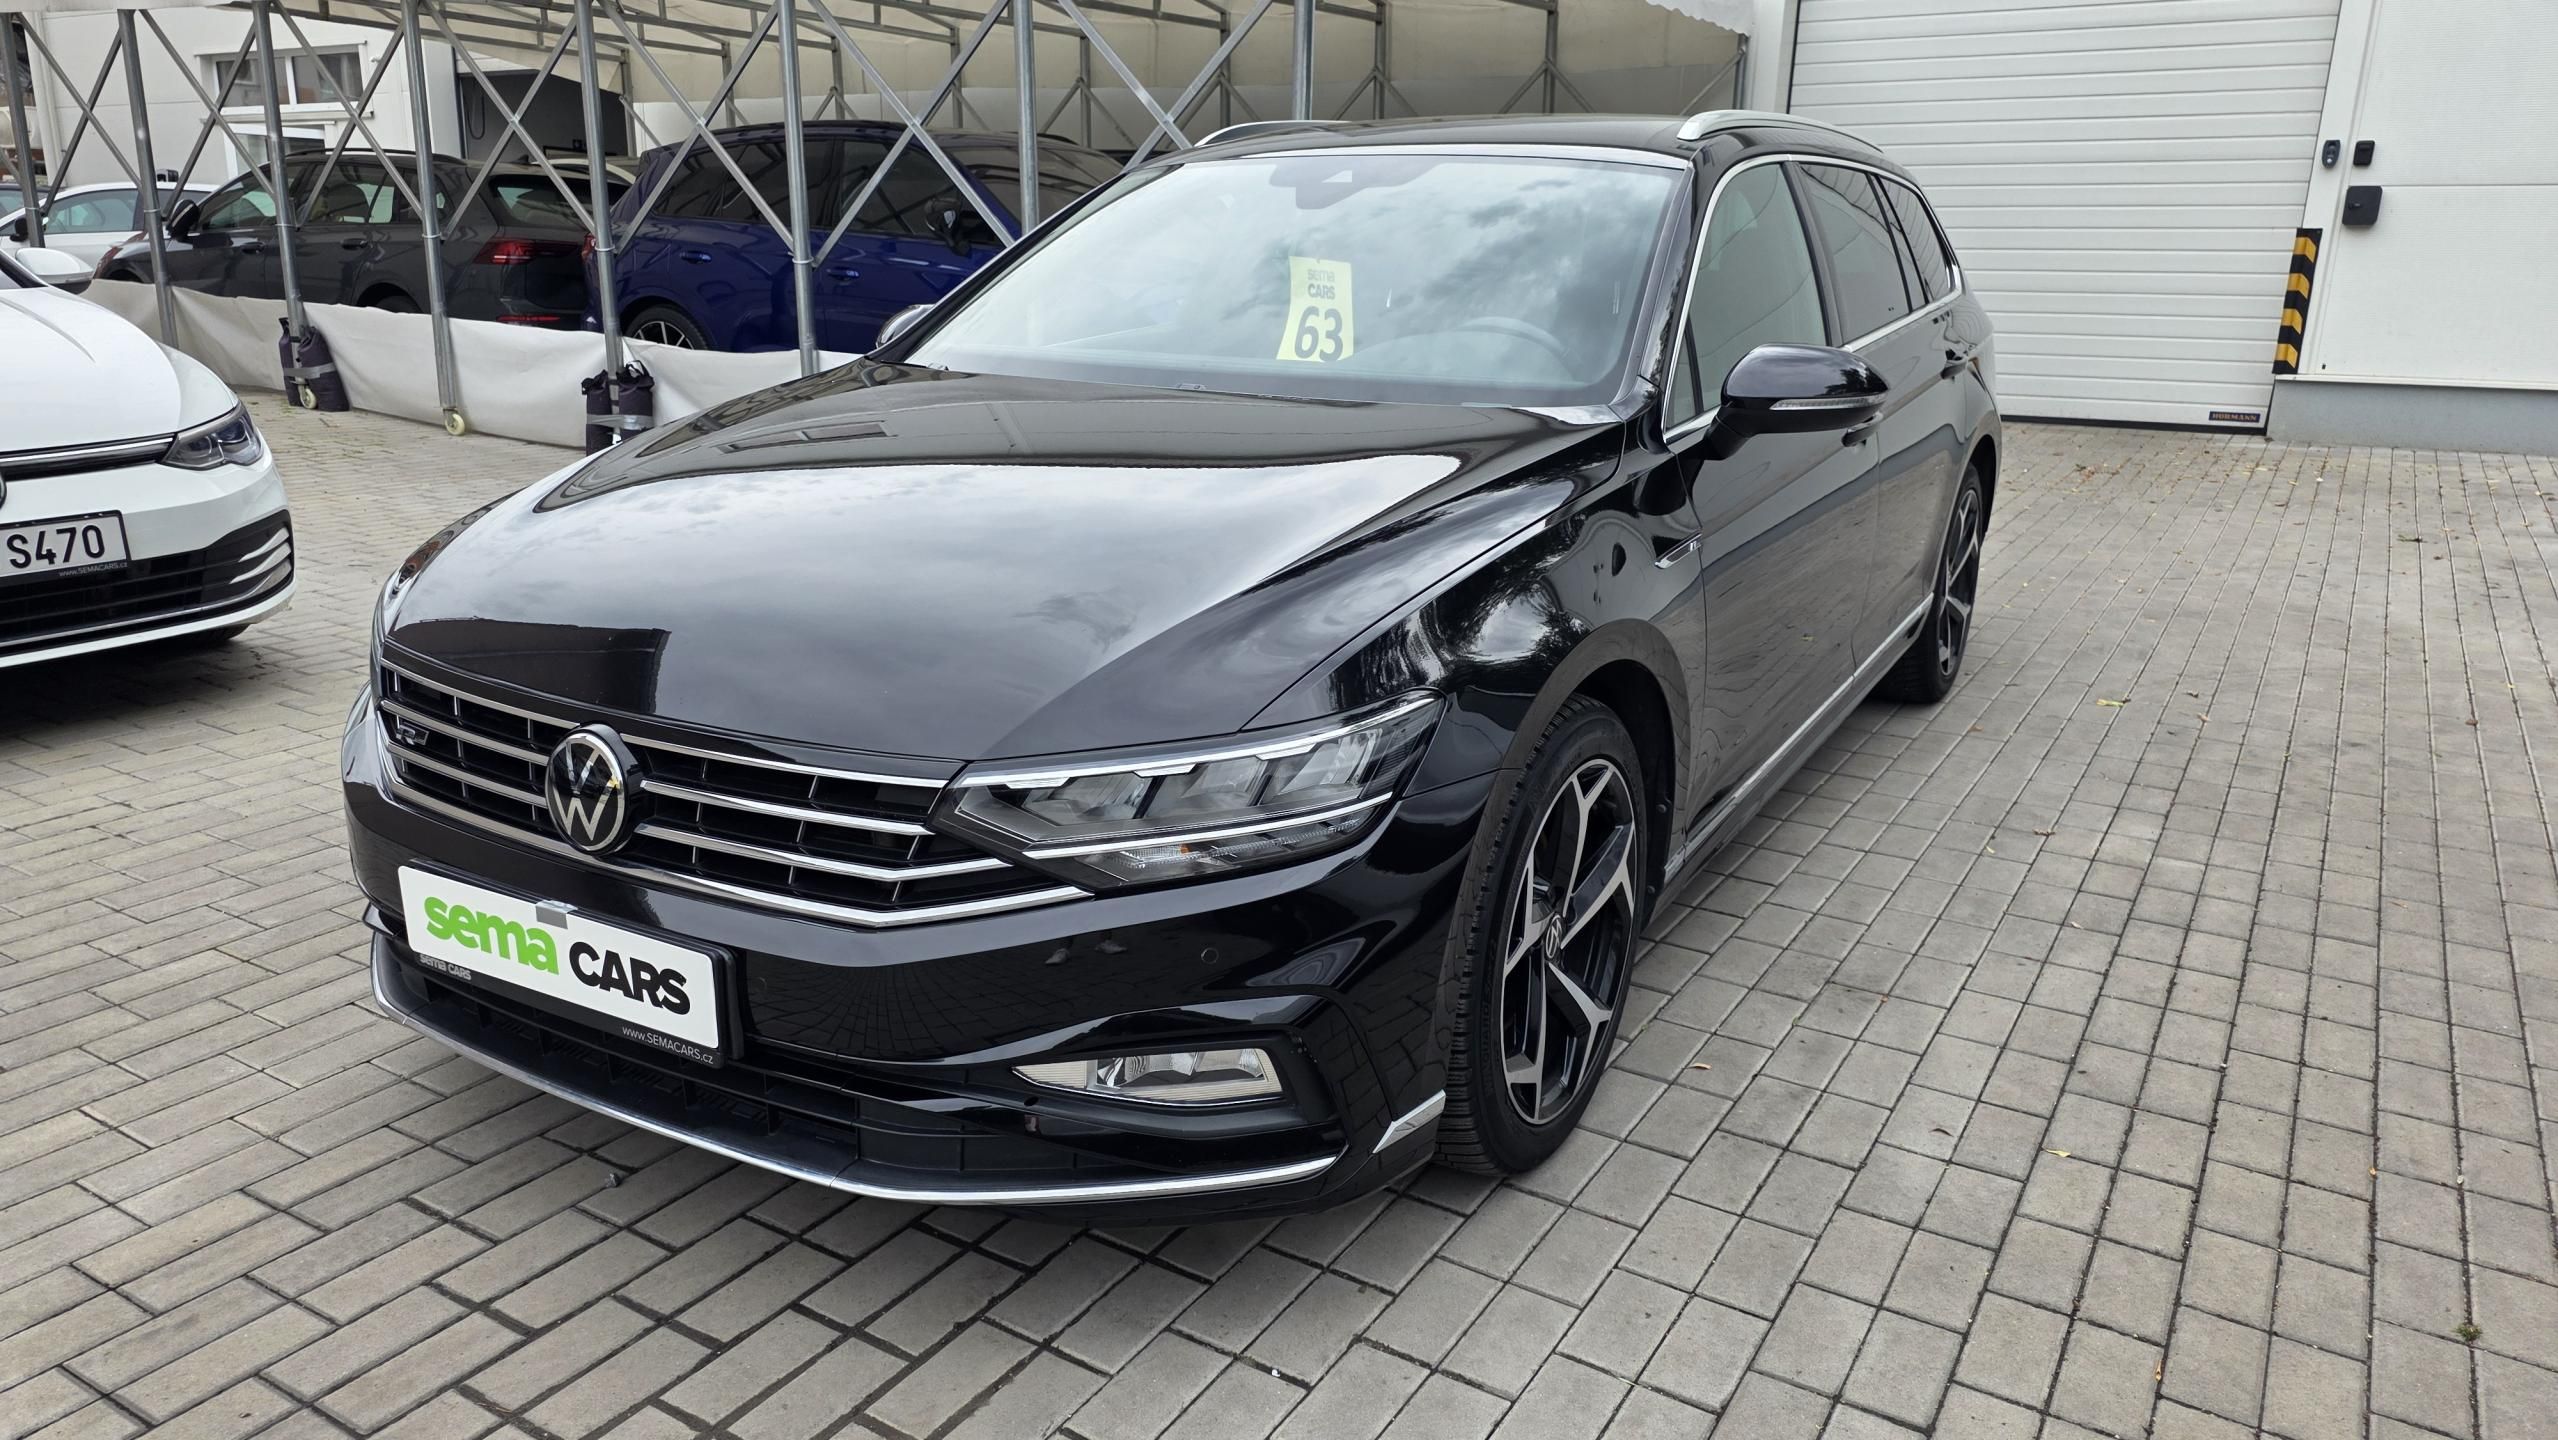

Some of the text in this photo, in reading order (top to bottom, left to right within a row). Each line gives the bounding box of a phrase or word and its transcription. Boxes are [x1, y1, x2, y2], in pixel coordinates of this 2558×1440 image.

[1308, 283, 1336, 300] CARS
[1294, 306, 1343, 362] 63
[7, 525, 105, 569] S470
[424, 896, 691, 1015] sema CARS
[447, 963, 472, 981] CARS
[622, 1026, 714, 1065] www.SEMACARS.cz
